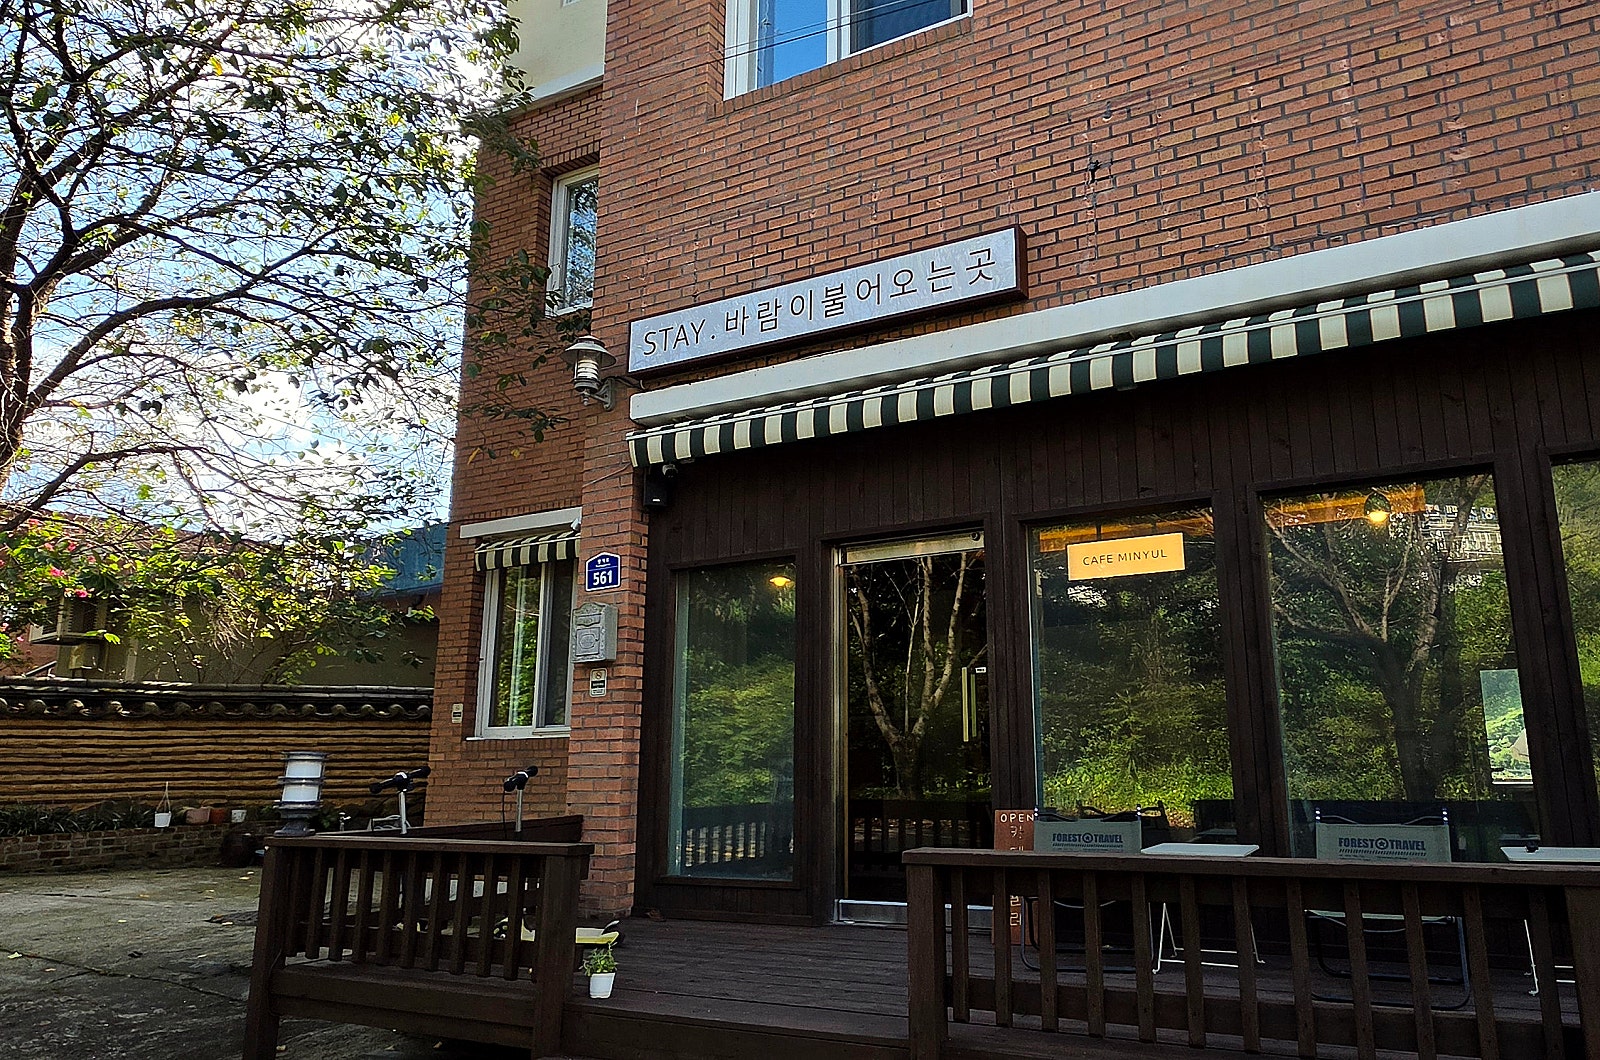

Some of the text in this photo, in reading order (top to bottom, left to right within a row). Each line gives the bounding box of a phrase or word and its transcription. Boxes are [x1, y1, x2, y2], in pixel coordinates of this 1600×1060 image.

[1082, 549, 1168, 566] CAFE MINYUL
[592, 569, 613, 586] 561
[1000, 813, 1034, 823] OPEN
[1052, 832, 1123, 844] FOREST TRAVEL
[1338, 837, 1426, 851] FOREST TRAVEL
